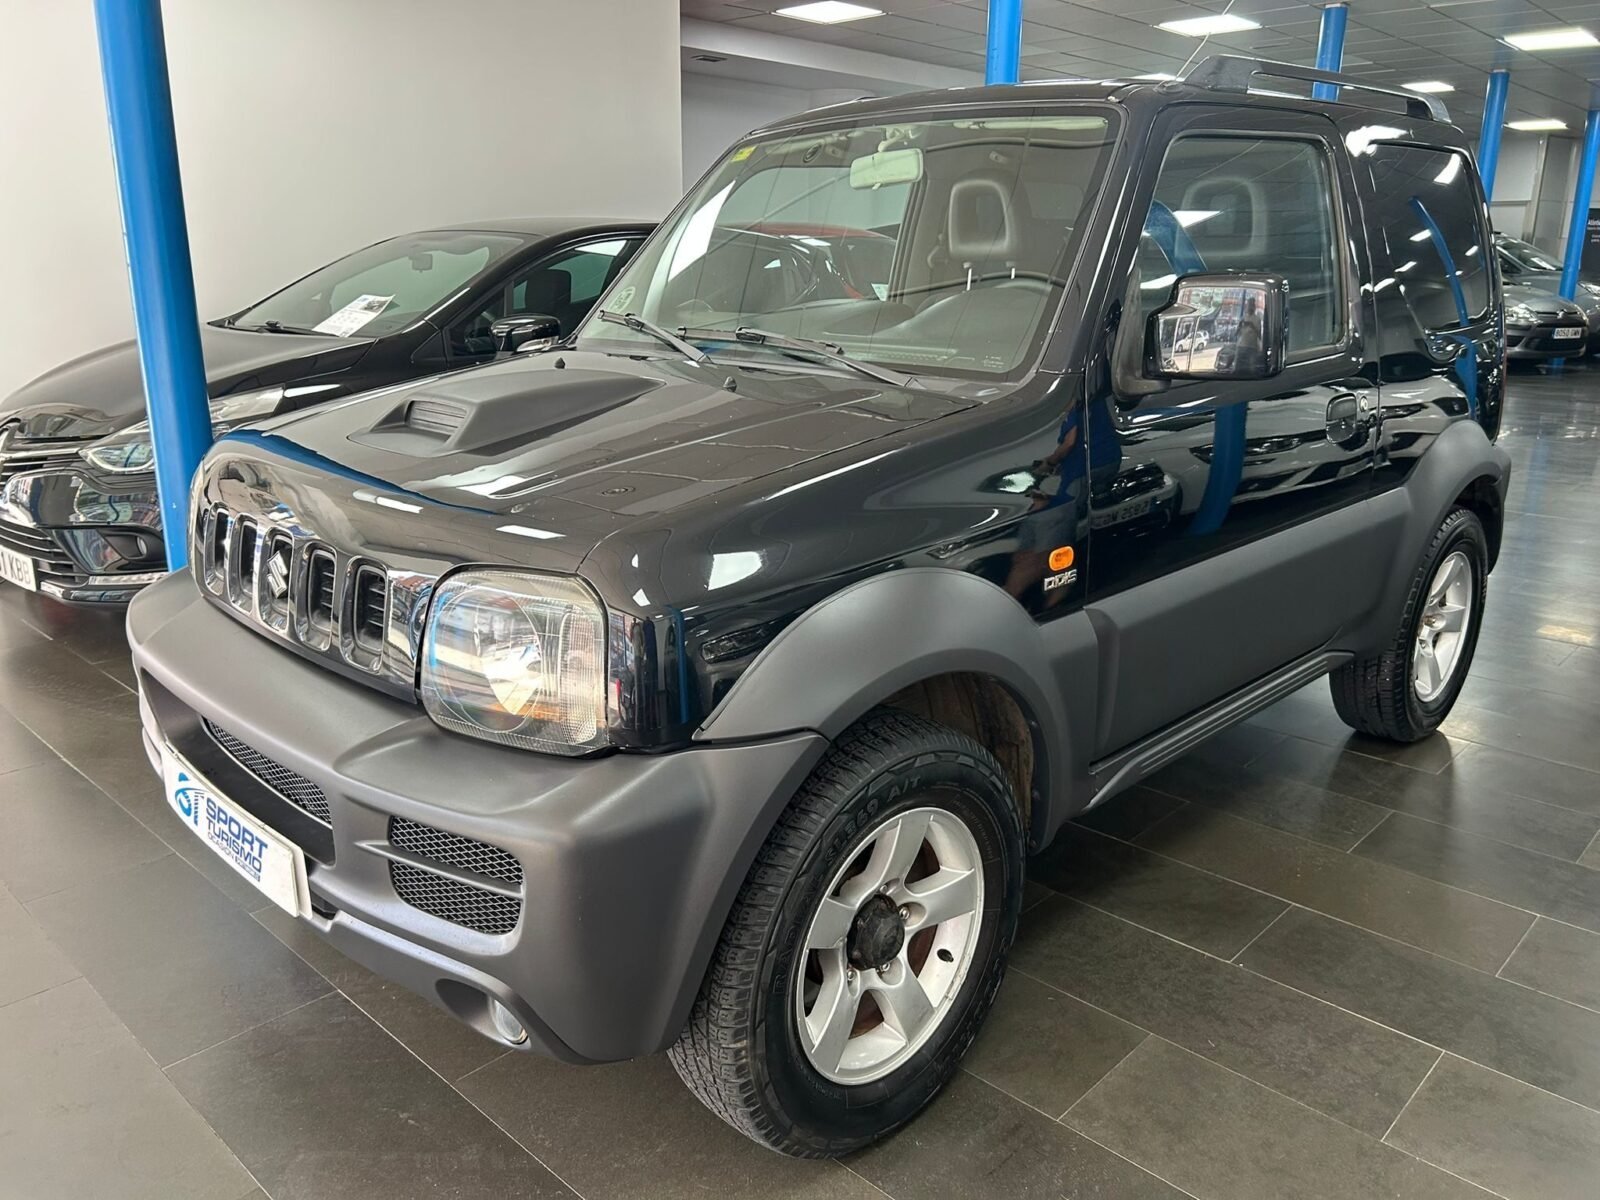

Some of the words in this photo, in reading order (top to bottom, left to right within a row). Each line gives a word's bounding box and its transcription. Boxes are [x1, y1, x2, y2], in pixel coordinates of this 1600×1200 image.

[887, 775, 921, 802] A/T
[206, 797, 268, 859] SPORT
[206, 817, 262, 873] TURISMO
